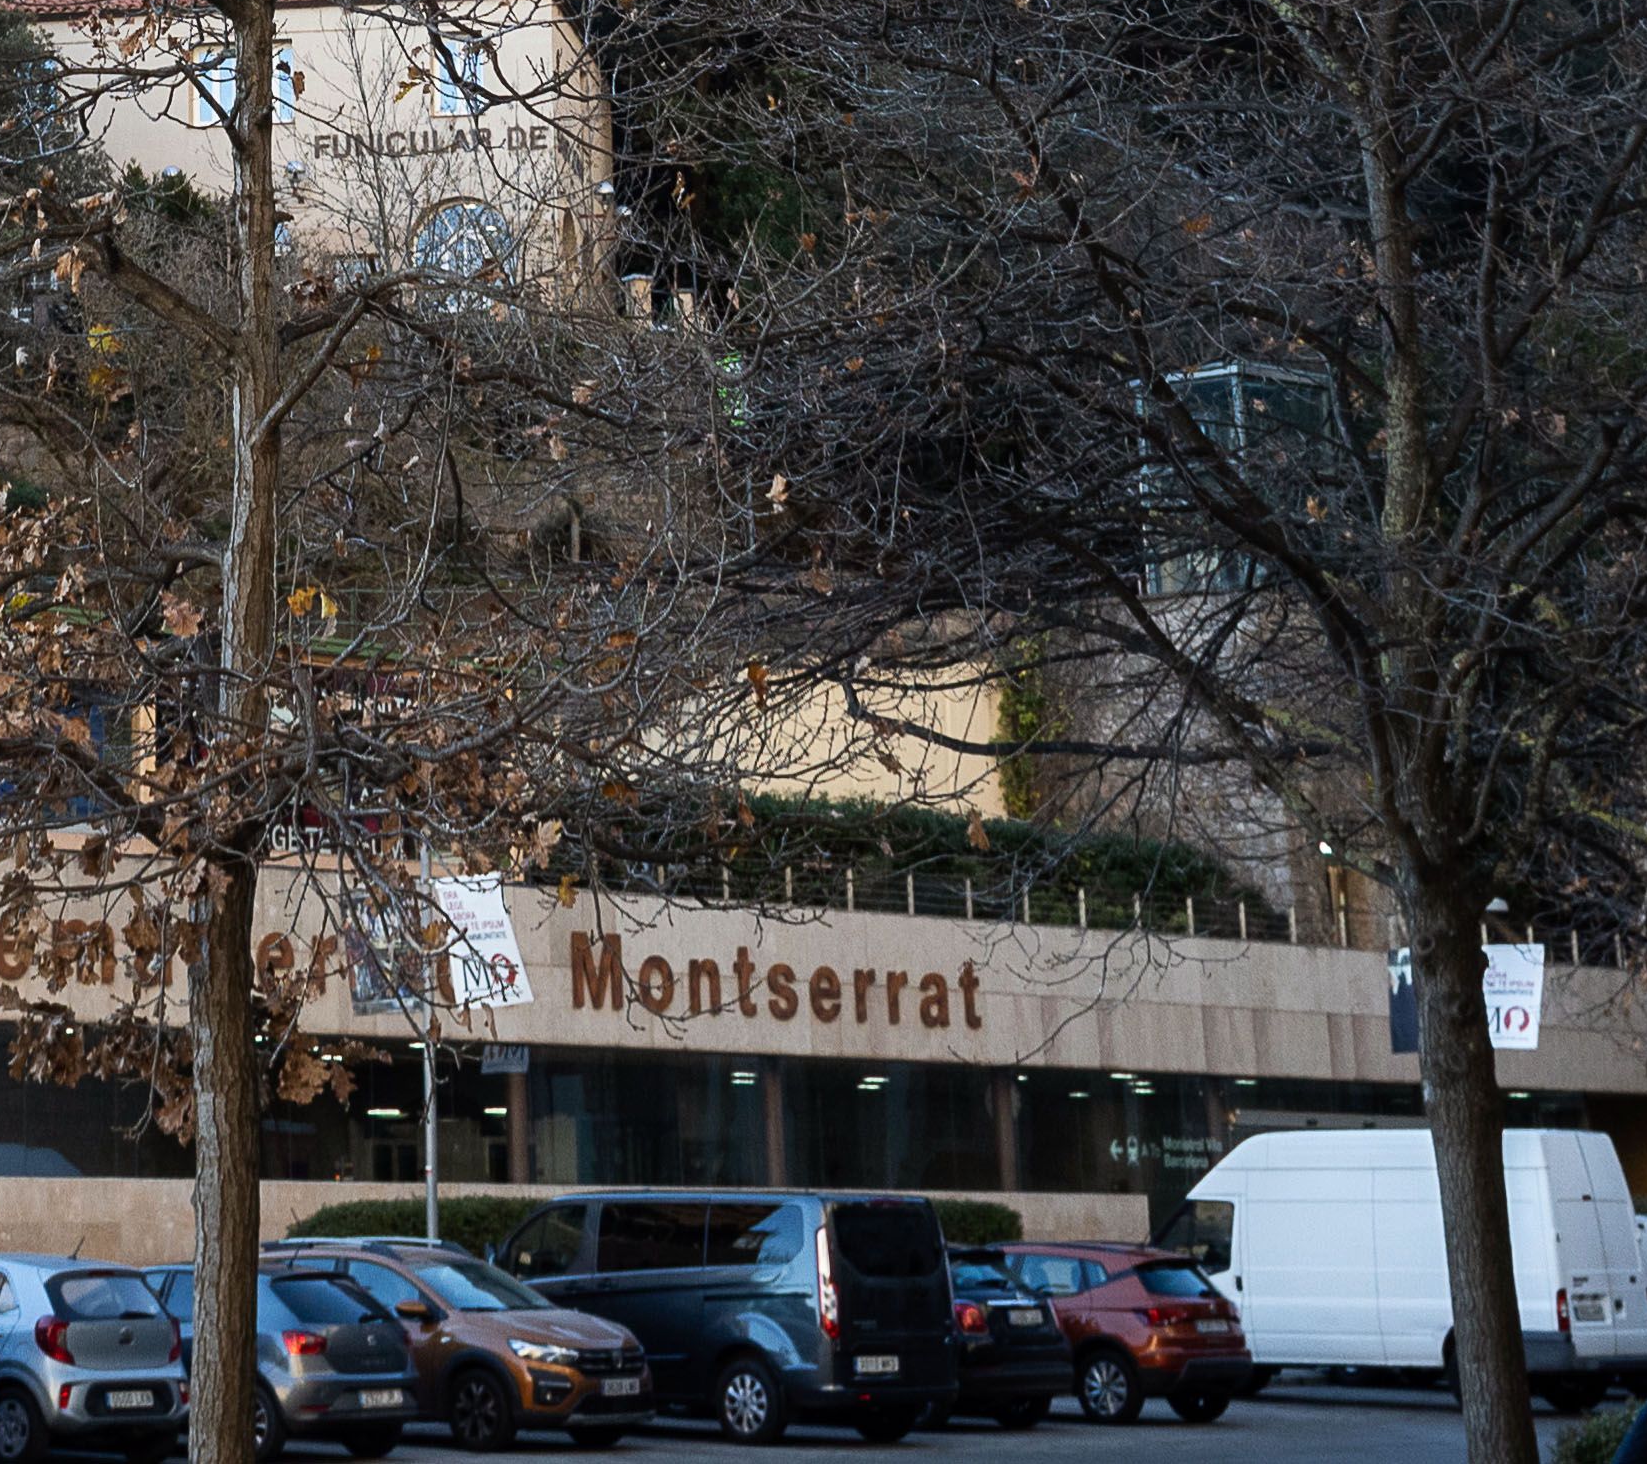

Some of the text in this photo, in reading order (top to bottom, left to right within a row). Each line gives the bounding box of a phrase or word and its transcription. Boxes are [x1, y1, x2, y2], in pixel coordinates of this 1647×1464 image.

[314, 124, 549, 159] FUNICULAR DE
[570, 930, 983, 1030] Montserrat
[1163, 1137, 1205, 1152] Monistrol
[1163, 1153, 1209, 1169] Barcelona
